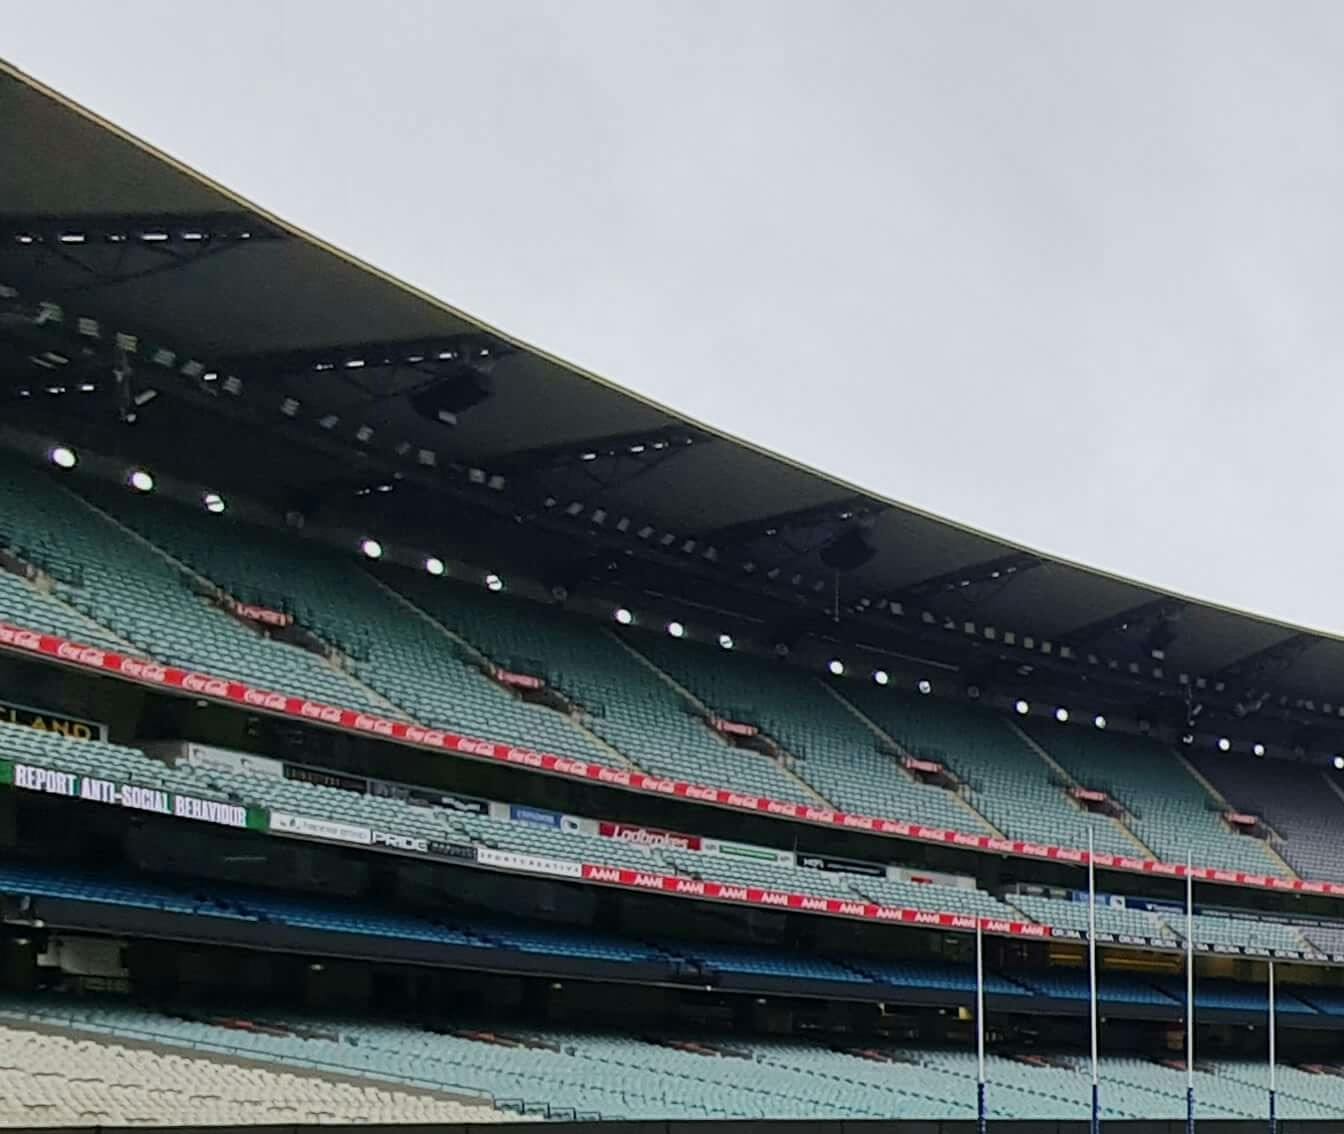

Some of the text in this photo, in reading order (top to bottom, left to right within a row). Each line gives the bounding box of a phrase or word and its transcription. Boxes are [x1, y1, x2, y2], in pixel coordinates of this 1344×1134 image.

[15, 764, 77, 796] REPORT
[81, 777, 172, 815] ANTI-SOCIAL
[174, 795, 246, 829] BEHAVIOUR
[612, 825, 689, 849] Ladbrokes
[590, 868, 620, 882] AAMI
[634, 875, 662, 889] AAMI
[676, 880, 703, 894] AAMI
[719, 888, 747, 901] AAMI
[761, 893, 788, 906] AAMI
[801, 898, 827, 911] AAMI
[839, 903, 865, 916] AAMI
[876, 907, 902, 920] AAMI
[914, 912, 940, 924] AAMI
[951, 916, 976, 928] AAMI
